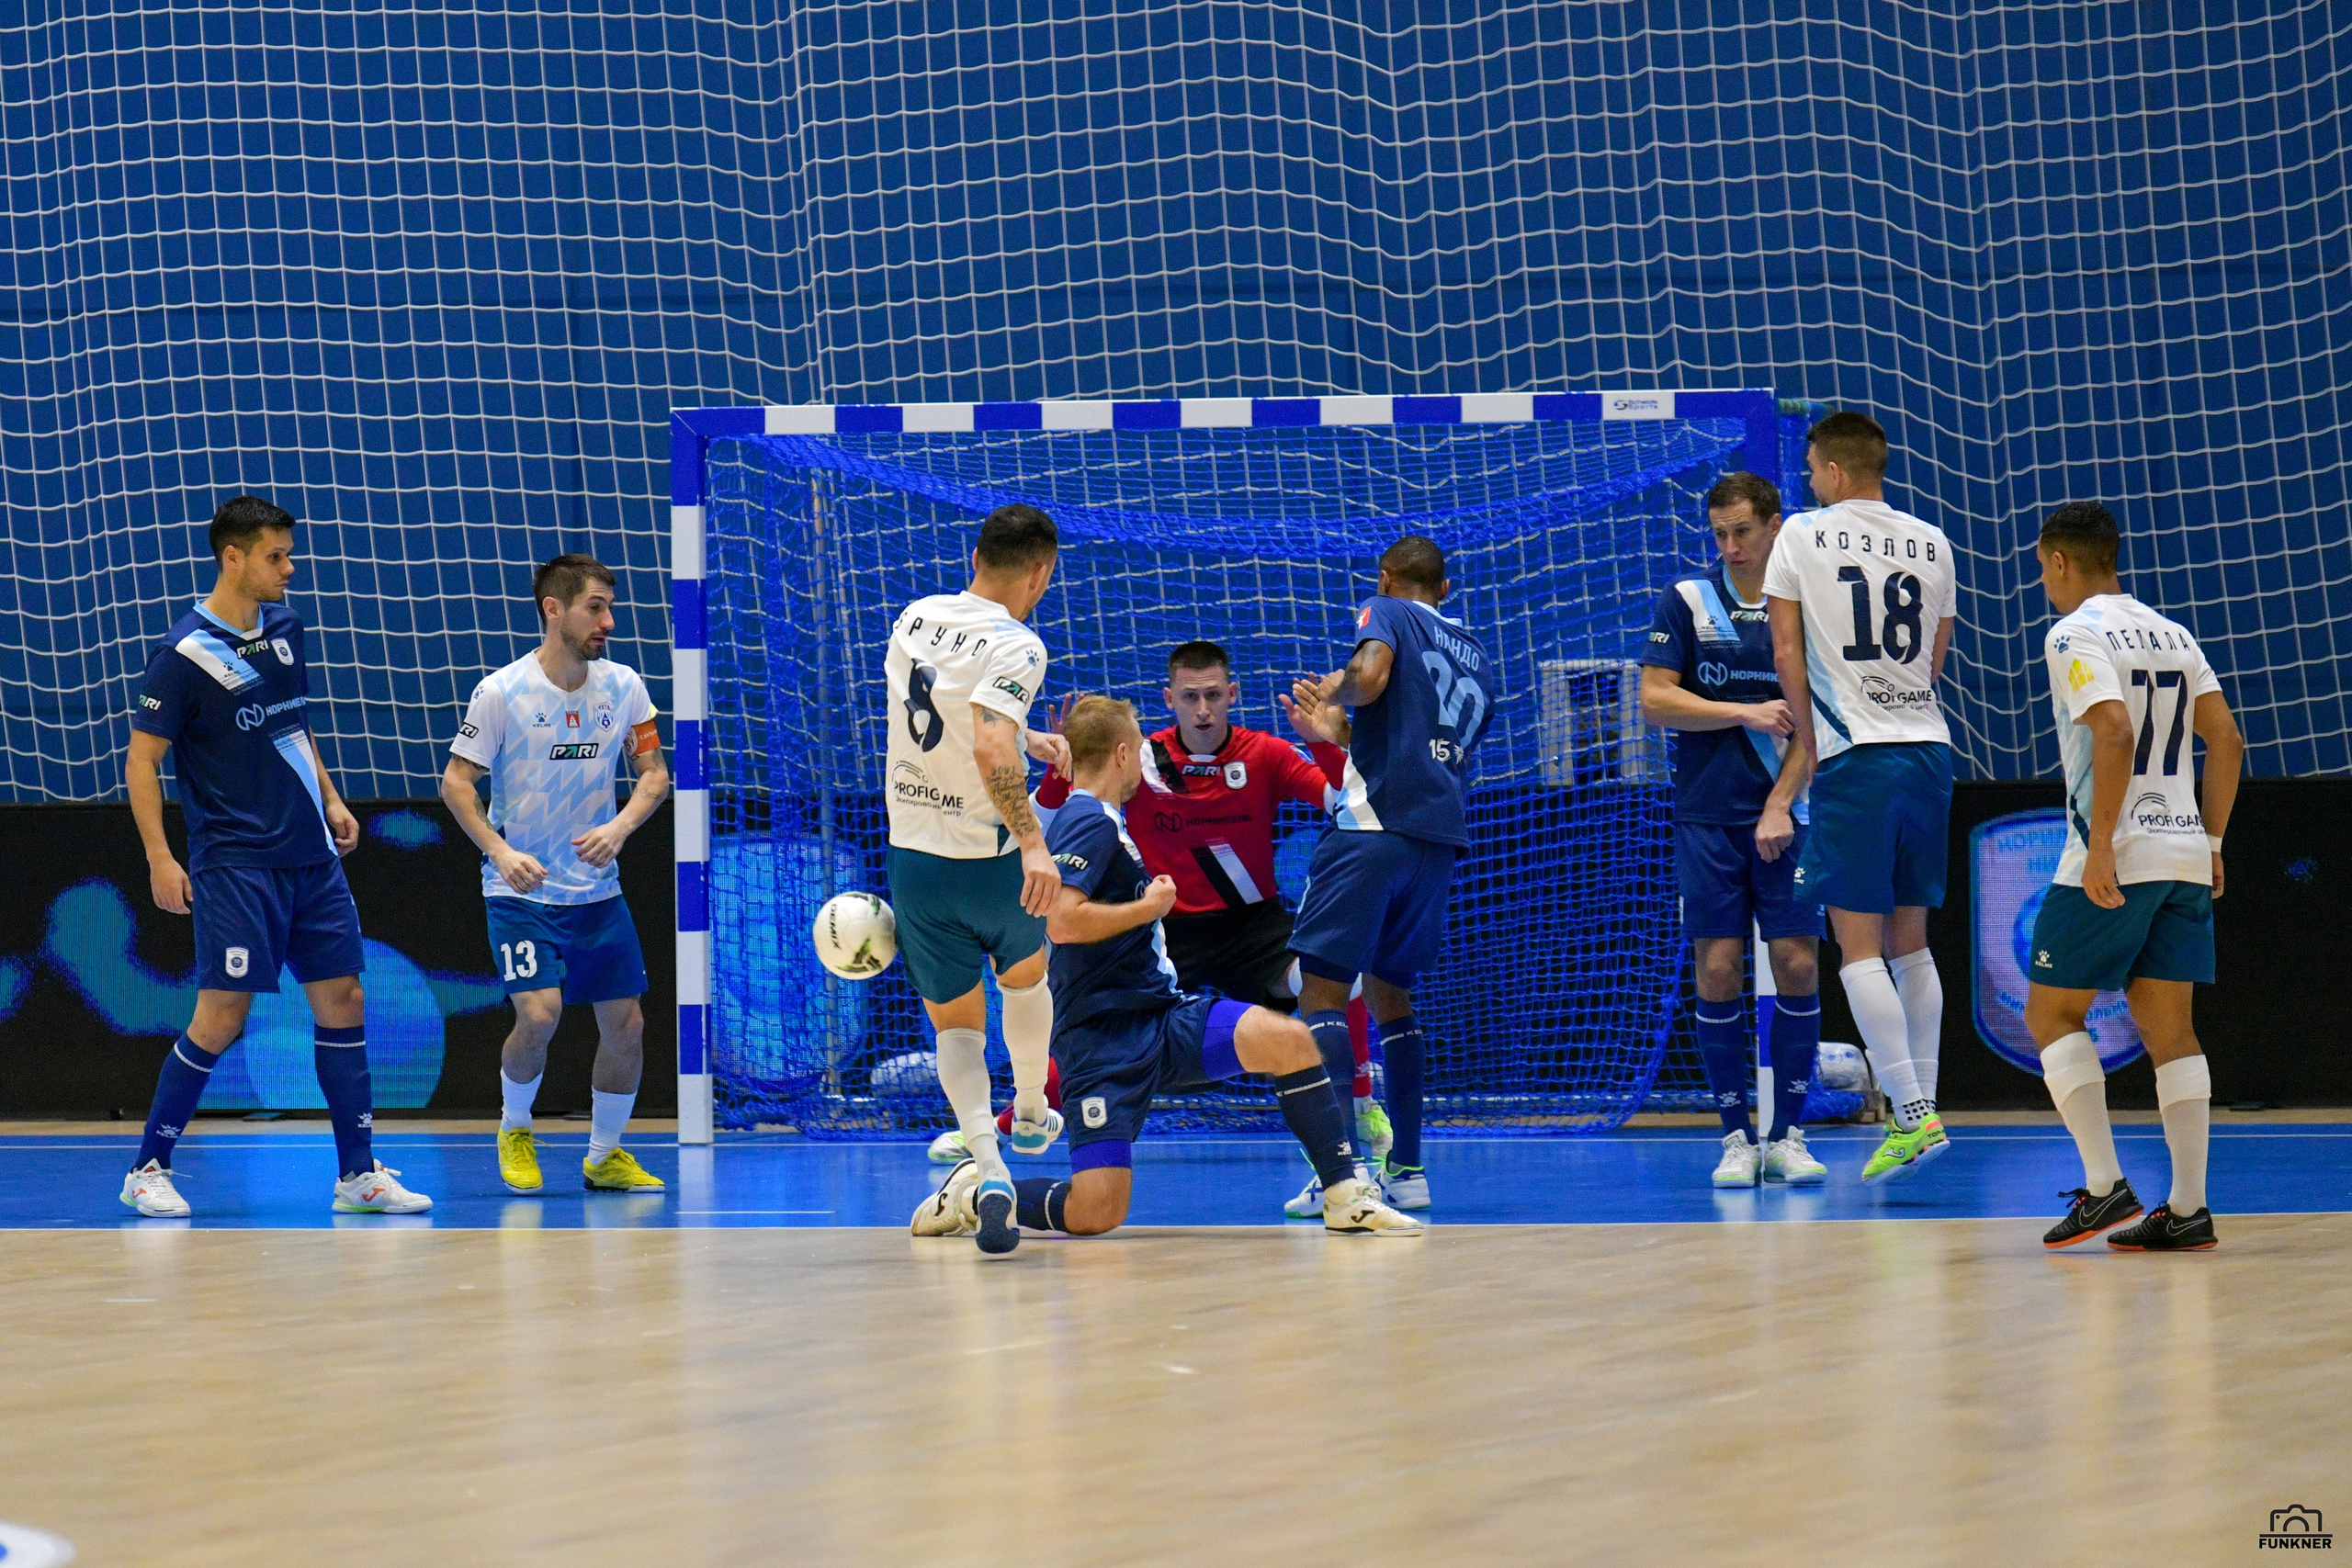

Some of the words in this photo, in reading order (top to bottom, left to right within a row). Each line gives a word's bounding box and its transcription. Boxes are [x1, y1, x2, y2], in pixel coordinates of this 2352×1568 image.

[1815, 530, 1936, 562] КОЗЛОВ
[1838, 565, 1924, 665] 18
[237, 638, 269, 659] PARI
[1434, 626, 1480, 671] НАНДО
[1730, 670, 1779, 682] НОРНИК
[138, 694, 162, 711] ARI
[903, 658, 944, 752] 8
[1422, 650, 1485, 750] 20
[459, 723, 478, 738] RI
[2132, 669, 2188, 776] 77
[550, 743, 599, 760] PARI
[1429, 739, 1451, 763] 15
[1182, 764, 1221, 776] PARI
[500, 940, 537, 982] 13
